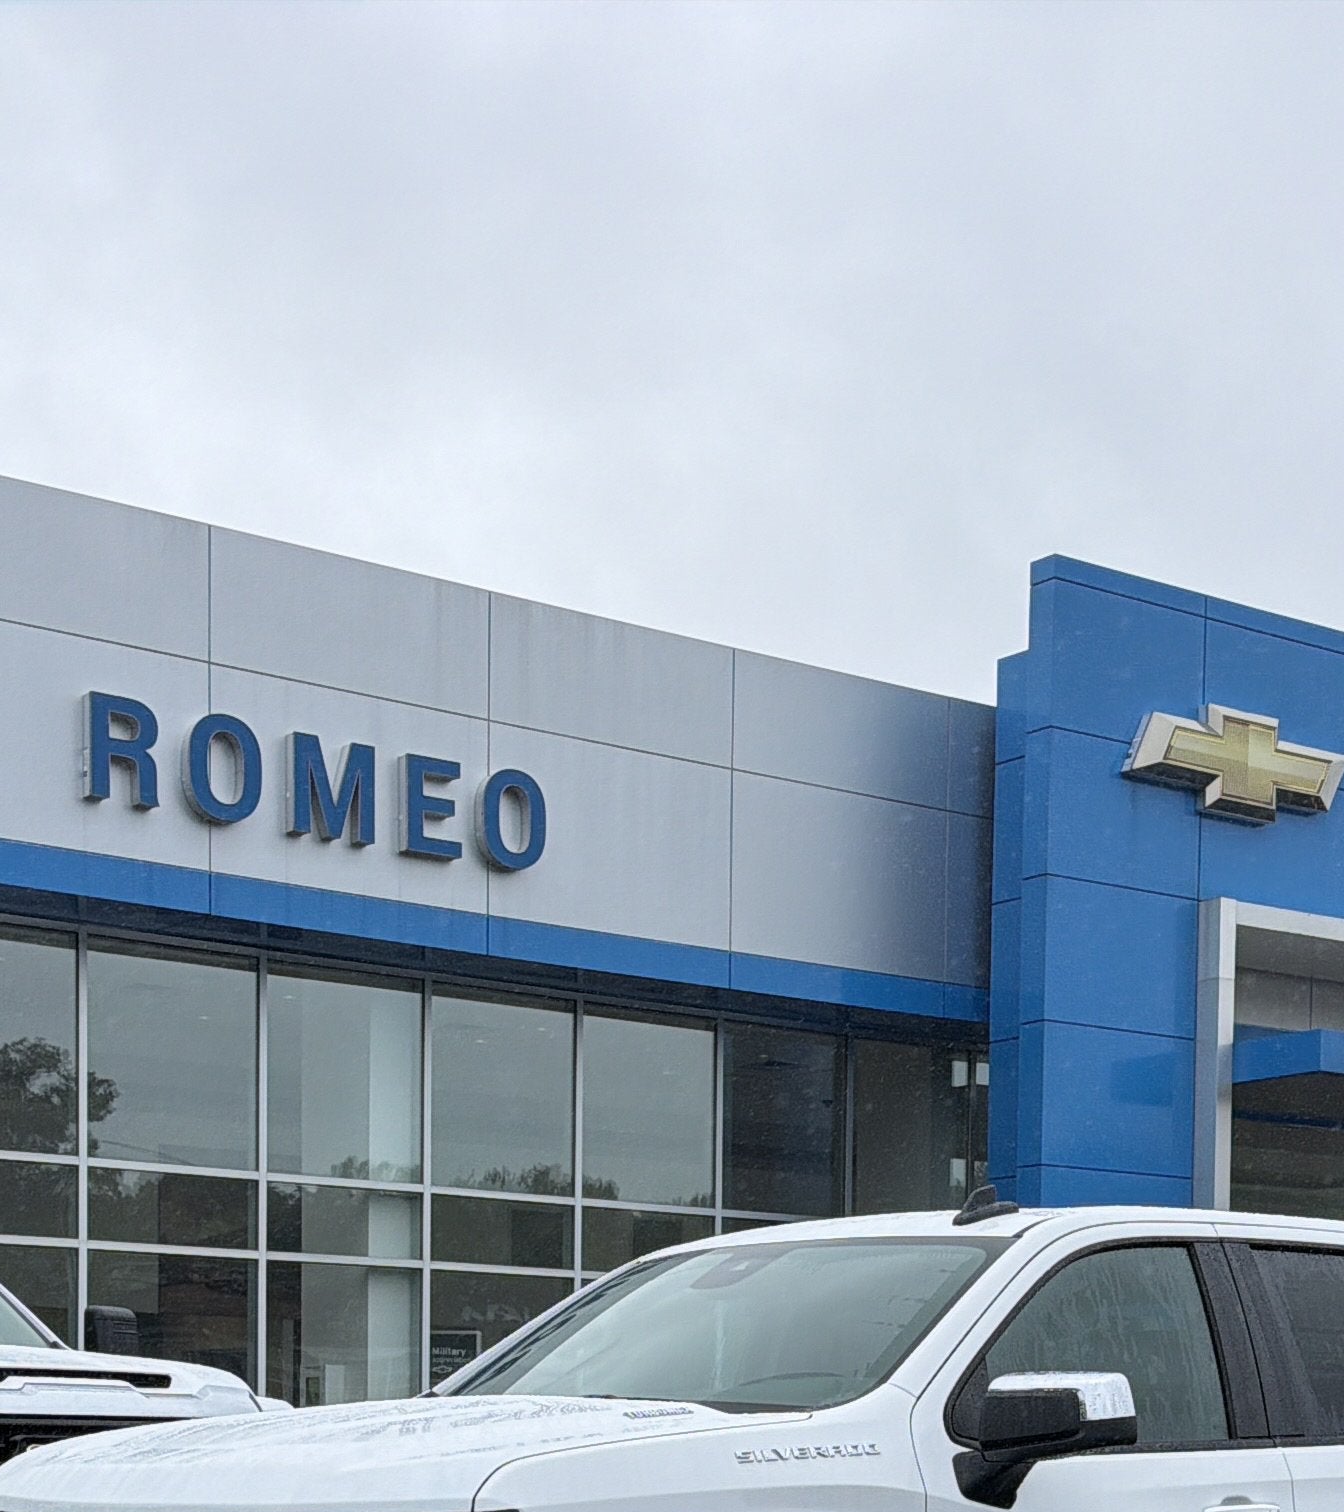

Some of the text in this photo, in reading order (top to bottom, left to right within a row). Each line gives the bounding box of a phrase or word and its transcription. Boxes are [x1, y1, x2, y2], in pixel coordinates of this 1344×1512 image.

[82, 690, 546, 872] ROMEO
[432, 1346, 466, 1357] Military
[734, 1443, 881, 1464] SILVERADO
